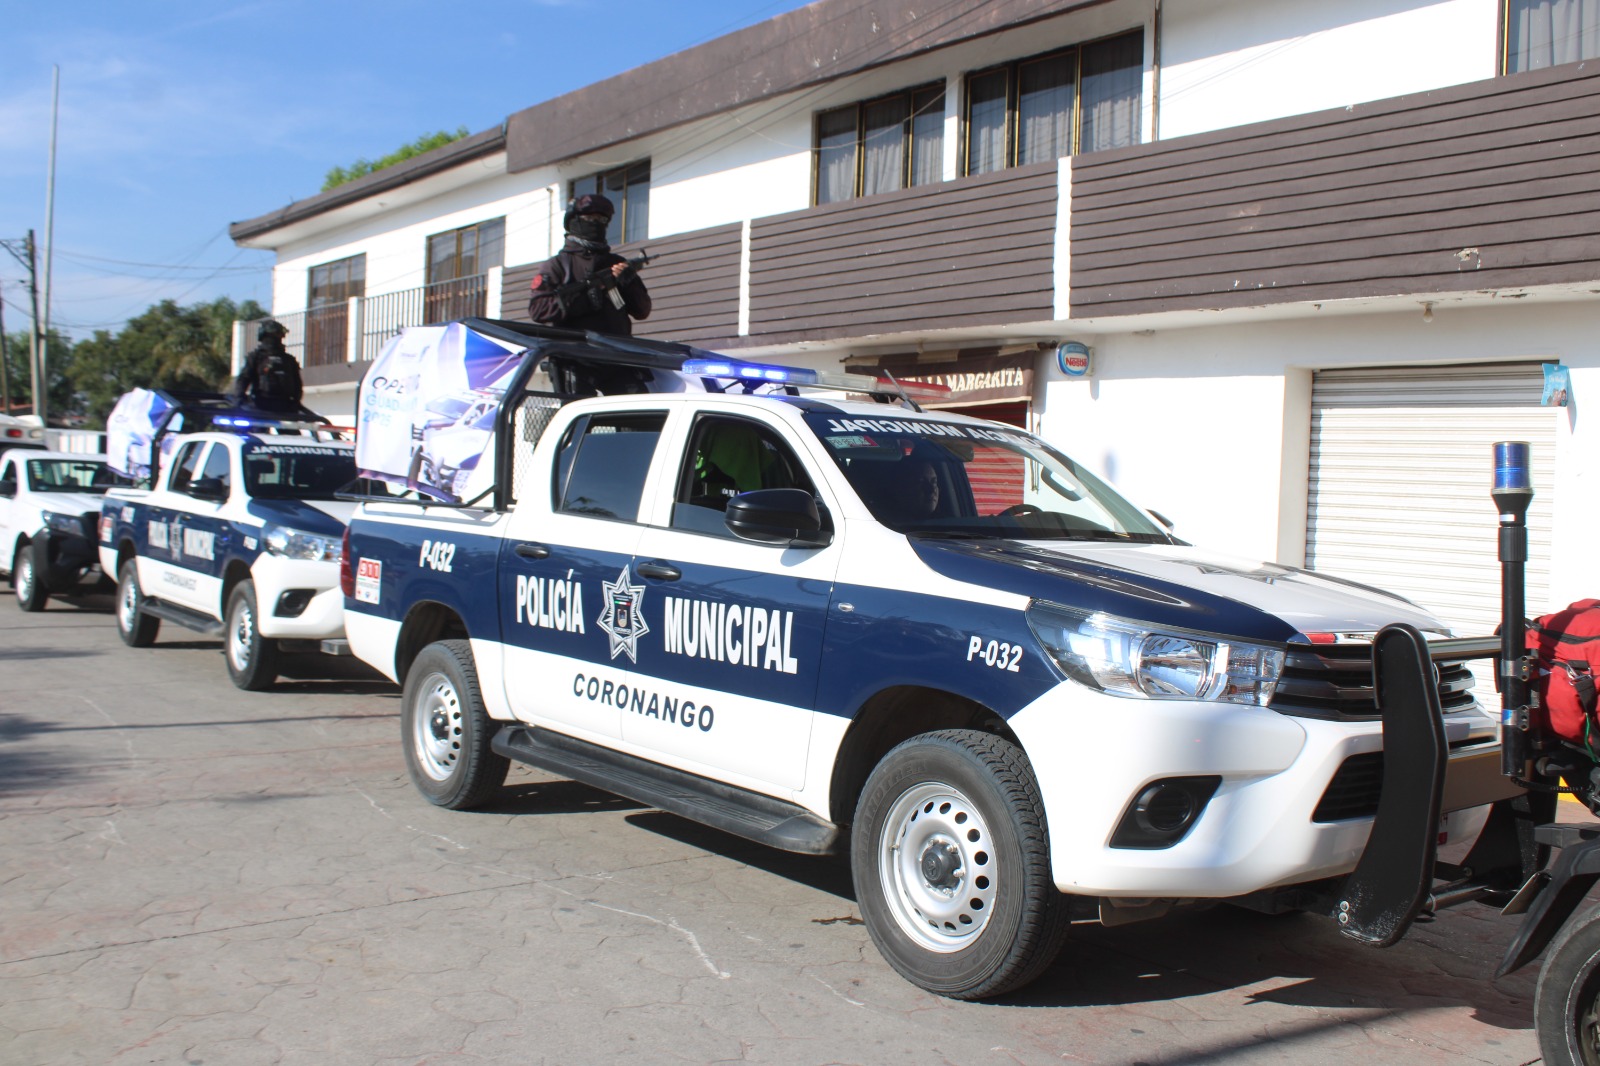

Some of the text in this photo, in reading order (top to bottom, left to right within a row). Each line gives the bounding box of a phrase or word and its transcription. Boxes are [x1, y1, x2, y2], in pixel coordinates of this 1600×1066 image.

[360, 562, 379, 578] 911
[419, 540, 456, 573] P-032
[516, 569, 798, 674] POLICÍA MUNICIPAL
[967, 636, 1023, 672] P-032
[573, 673, 714, 732] CORONANGO
